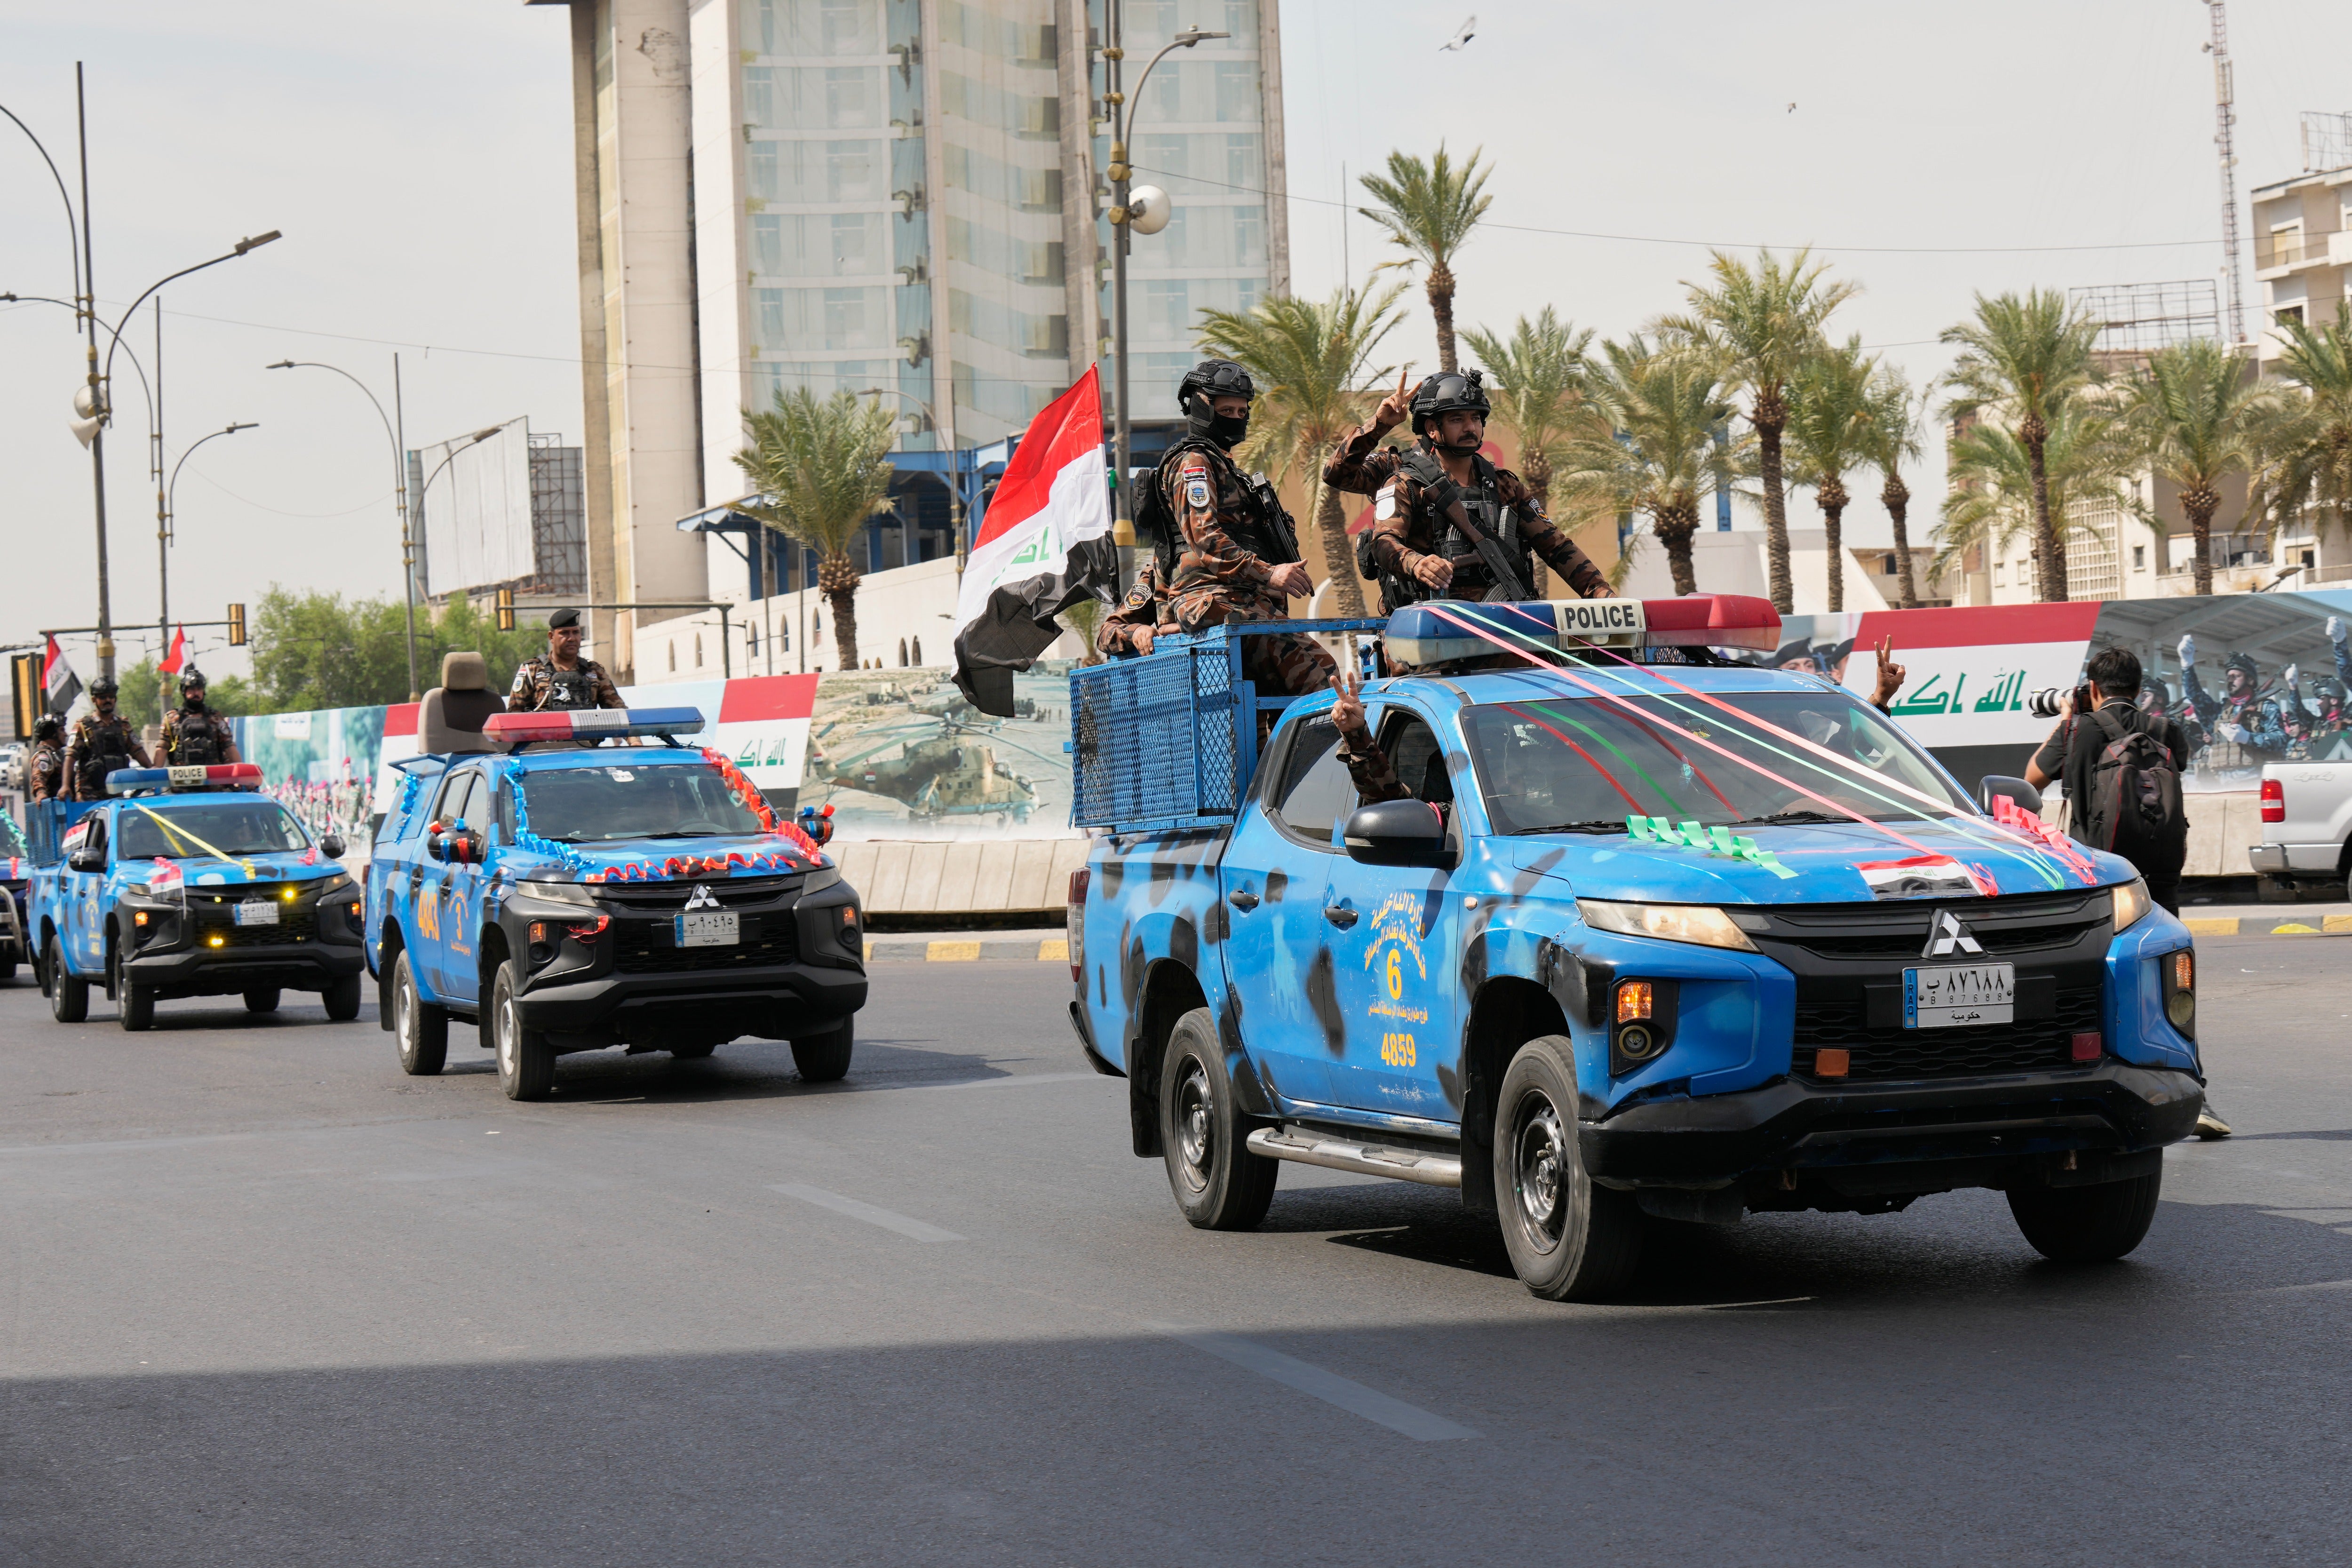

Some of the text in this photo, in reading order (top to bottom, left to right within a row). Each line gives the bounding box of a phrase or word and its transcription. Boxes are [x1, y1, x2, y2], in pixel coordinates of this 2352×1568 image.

[1564, 605, 1636, 629] POLICE
[1890, 667, 2026, 716] الله اكب
[734, 737, 786, 767] الله اكب
[173, 768, 202, 778] POLICE
[2293, 772, 2336, 782] 4x4
[418, 889, 440, 941] 4843
[455, 902, 462, 940] 3
[700, 915, 733, 928] ٩٠٤٩٥
[1371, 891, 1425, 941] وزارة الداخلية
[1364, 926, 1385, 972] الرصافة
[1399, 918, 1414, 950] شرطة
[1387, 948, 1402, 1000] 6
[1927, 968, 2004, 994] ب ٨٧٦٨٨
[1397, 1004, 1407, 1023] بغداد
[1931, 993, 2002, 1004] B 87688
[1951, 1009, 1980, 1023] حكومية
[1381, 1033, 1416, 1067] 4859
